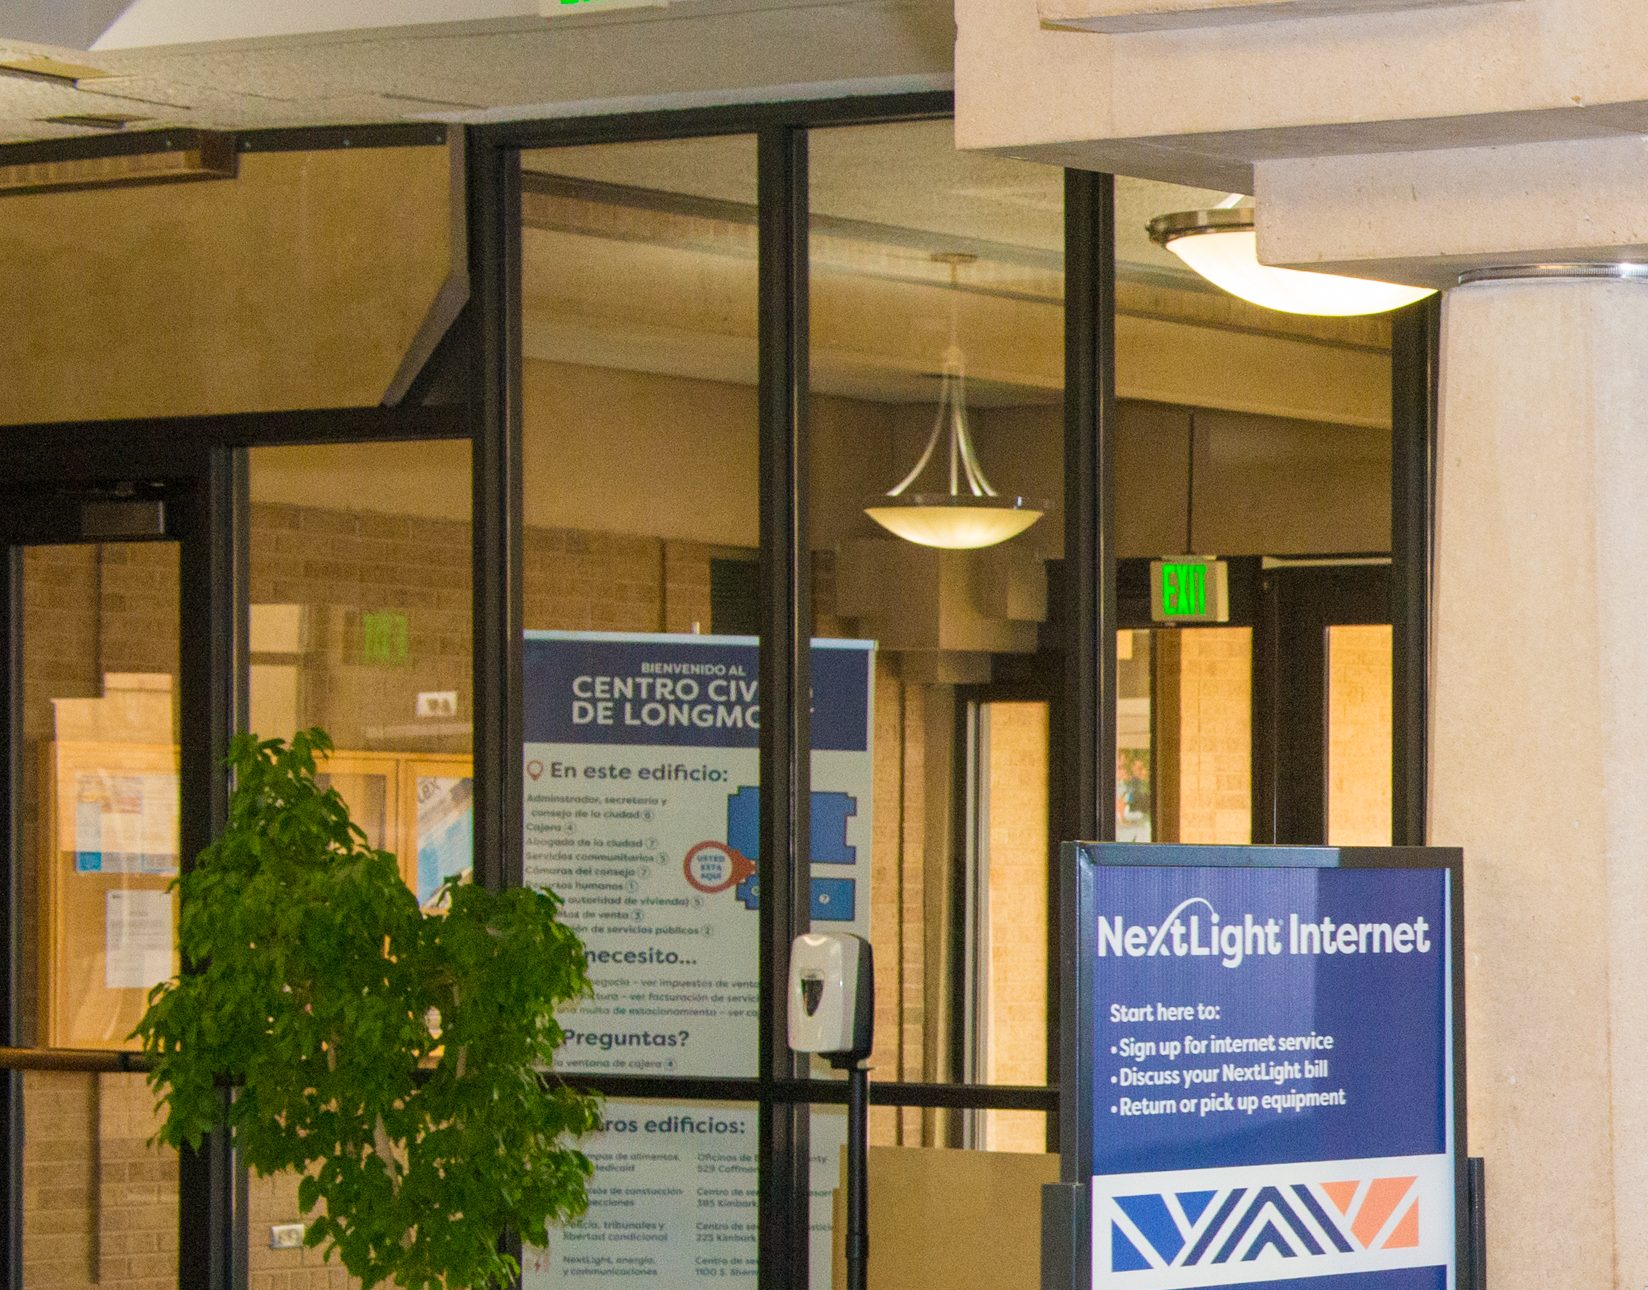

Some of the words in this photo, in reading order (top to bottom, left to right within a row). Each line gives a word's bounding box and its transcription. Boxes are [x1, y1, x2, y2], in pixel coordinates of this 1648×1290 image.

[1162, 564, 1207, 616] EXIT
[641, 661, 726, 675] BIENVENIDO
[729, 664, 746, 676] AL
[572, 675, 699, 701] CENTRO
[572, 701, 613, 725] DE
[625, 703, 814, 728] LONGMO
[551, 762, 577, 780] En
[583, 764, 632, 782] este
[638, 763, 729, 783] edificio:
[1290, 913, 1431, 955] Internet
[1110, 1003, 1154, 1023] Start
[1157, 1002, 1194, 1021] here
[1198, 1002, 1221, 1021] to:
[1119, 1038, 1155, 1062] Sign
[1159, 1039, 1180, 1057] up
[1184, 1035, 1208, 1055] for
[1210, 1034, 1275, 1054] internet
[1278, 1032, 1334, 1051] service
[1120, 1067, 1180, 1087] Discuss
[1183, 1068, 1219, 1086] your
[1222, 1063, 1302, 1085] NextLight
[1305, 1059, 1328, 1079] bill
[1120, 1097, 1176, 1116] Return
[1180, 1097, 1197, 1113] or
[1200, 1093, 1234, 1117] pick
[1237, 1095, 1258, 1115] up
[1261, 1089, 1347, 1112] equipment
[645, 1115, 746, 1134] edificios:
